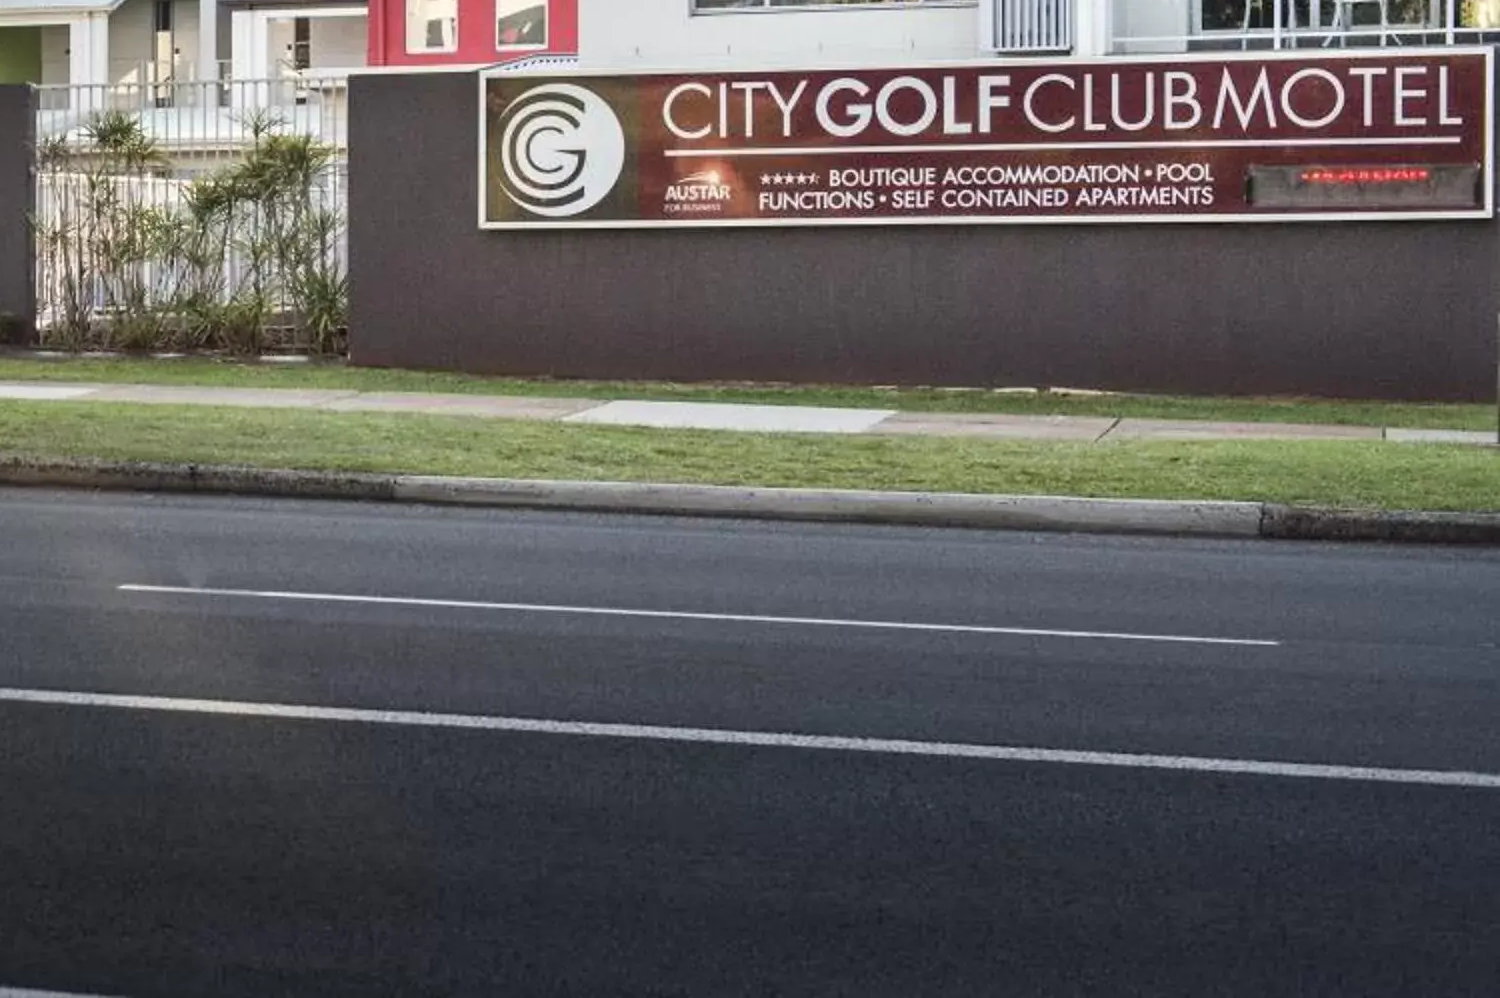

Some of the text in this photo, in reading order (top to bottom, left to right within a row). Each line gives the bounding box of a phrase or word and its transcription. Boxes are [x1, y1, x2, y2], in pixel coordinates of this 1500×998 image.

[662, 65, 1464, 139] CITY GOLF CLUB MOTEL
[828, 163, 1214, 187] BOUTIQUE ACCOMMODATION POOL
[664, 184, 731, 201] AUSTAR
[758, 185, 1214, 211] FUNCTIONS SELF CONTAINED APARTMENTS
